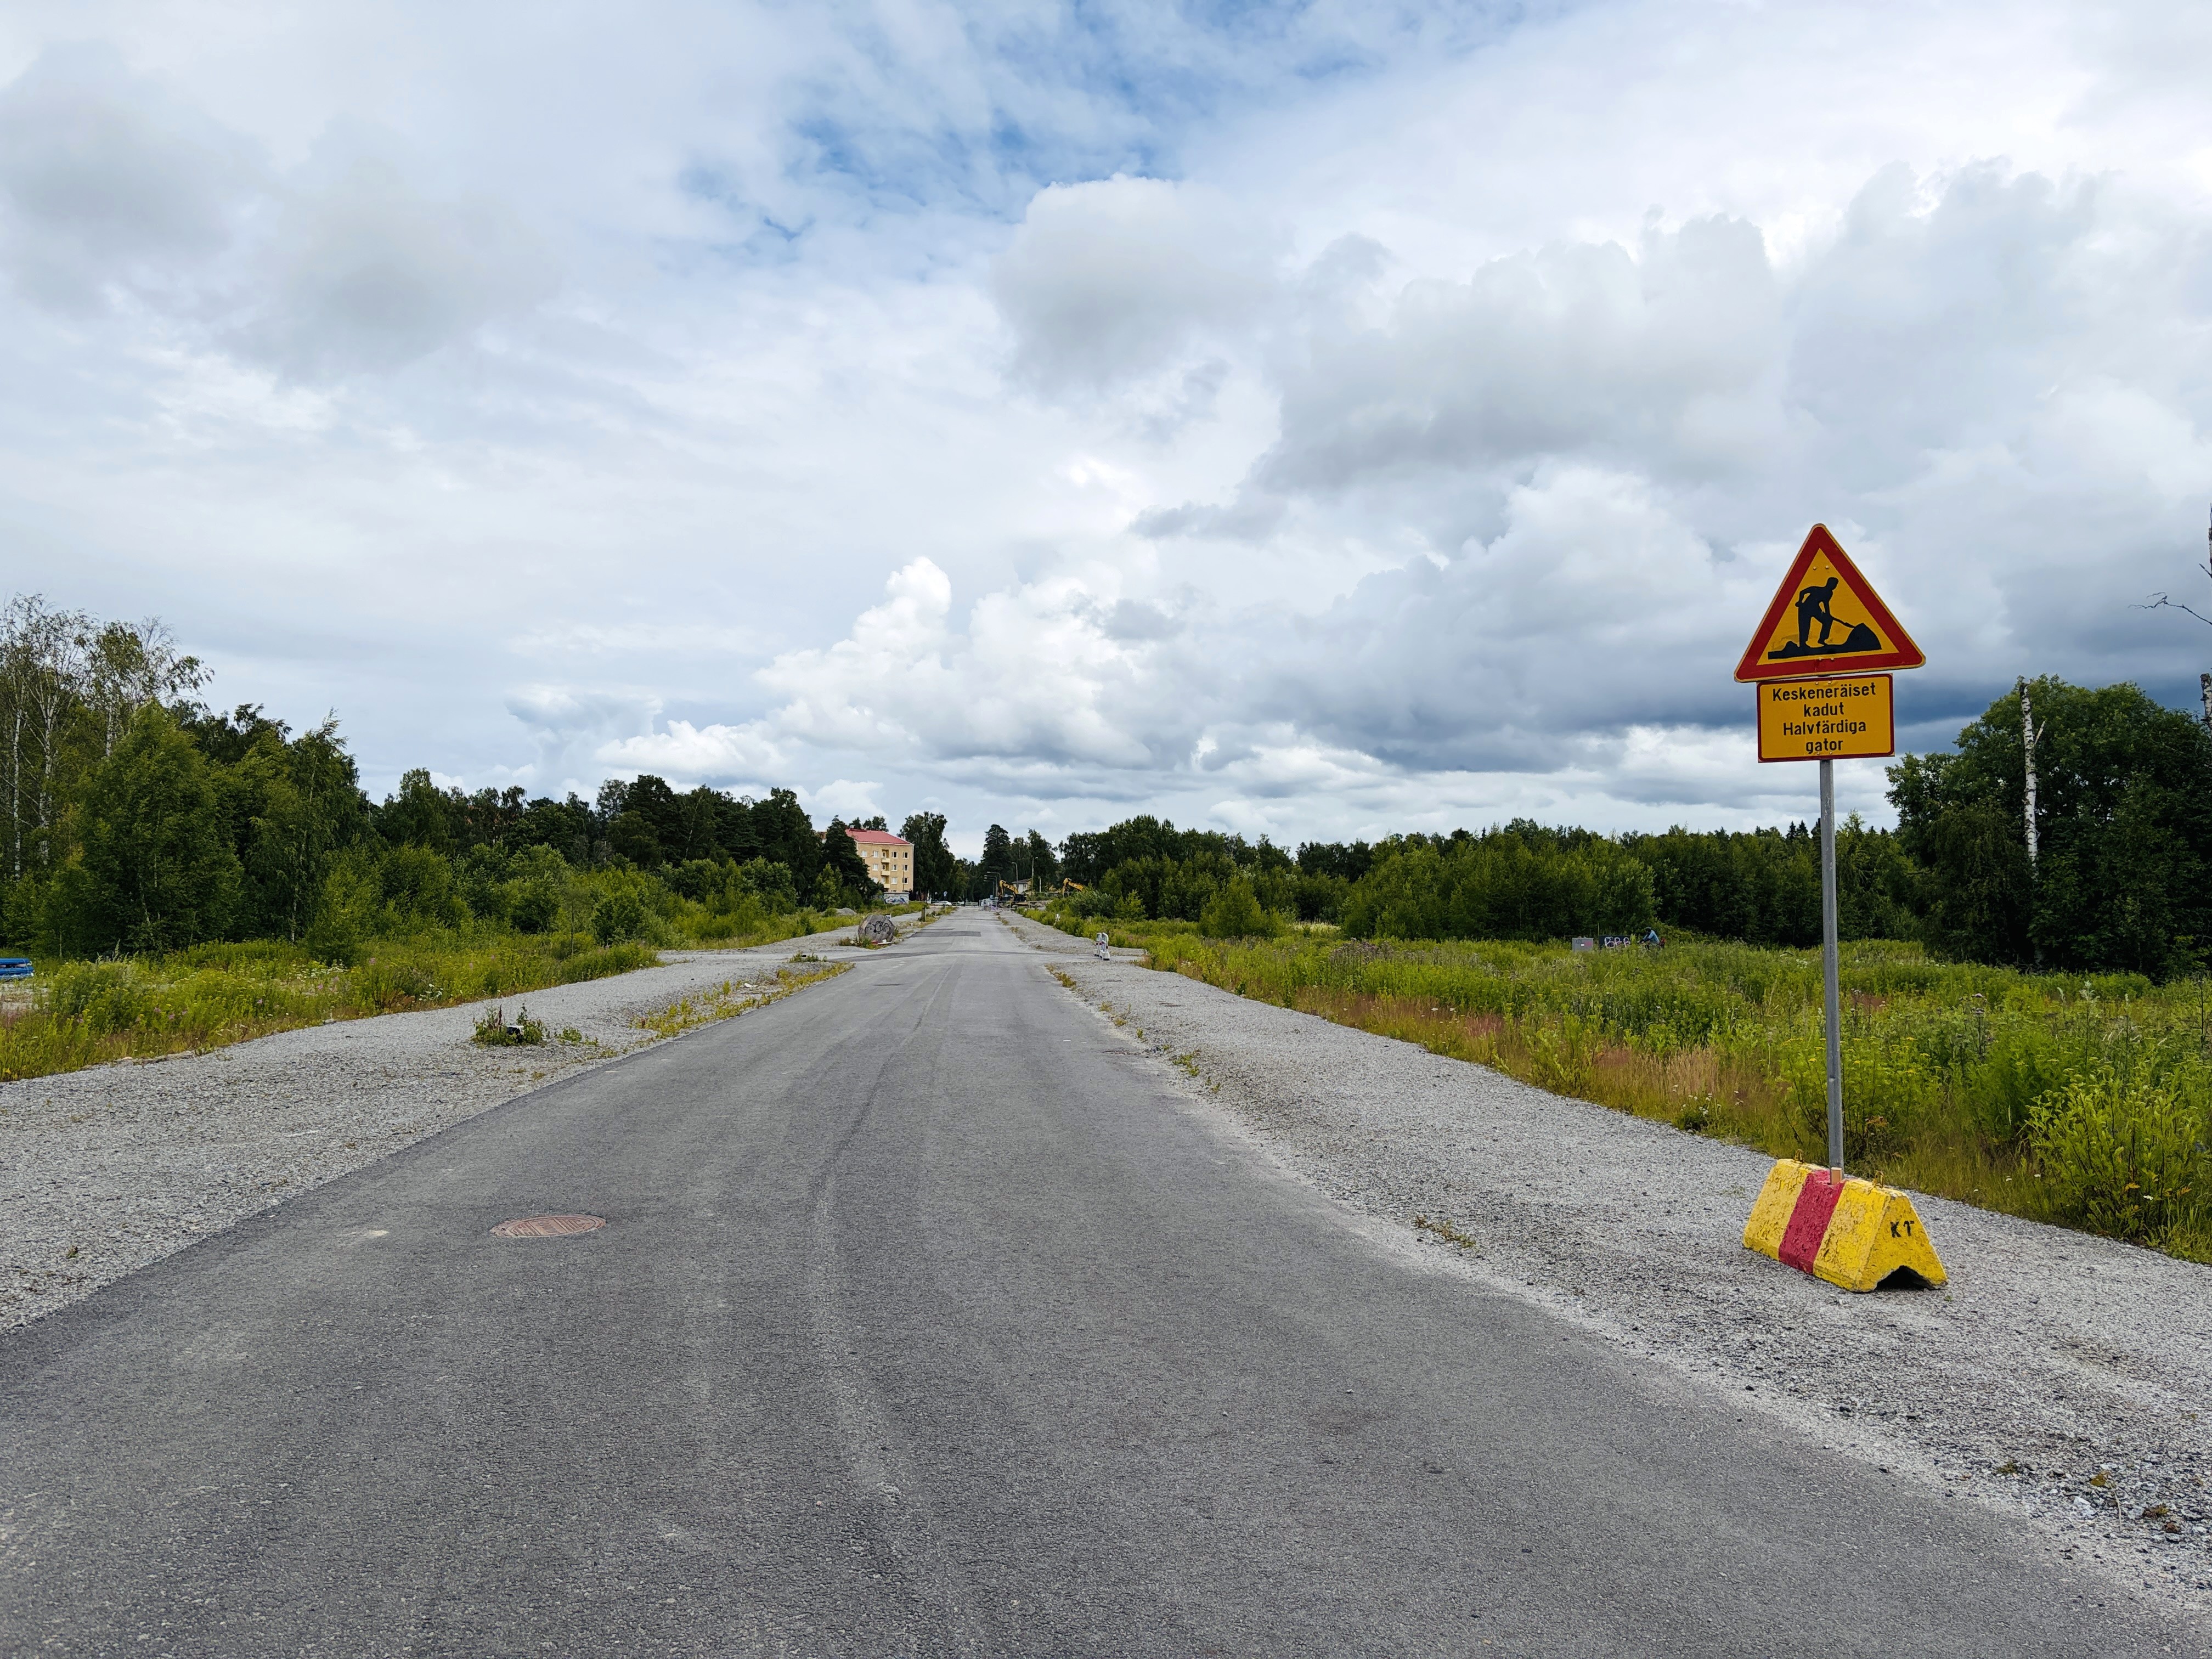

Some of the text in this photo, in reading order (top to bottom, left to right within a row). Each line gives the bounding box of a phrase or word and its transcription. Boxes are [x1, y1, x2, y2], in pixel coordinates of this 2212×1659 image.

[1773, 682, 1876, 702] Keskeneräiset
[1804, 702, 1844, 718] kadut
[1783, 719, 1866, 736] Halvfärdiga
[1805, 738, 1843, 754] gator
